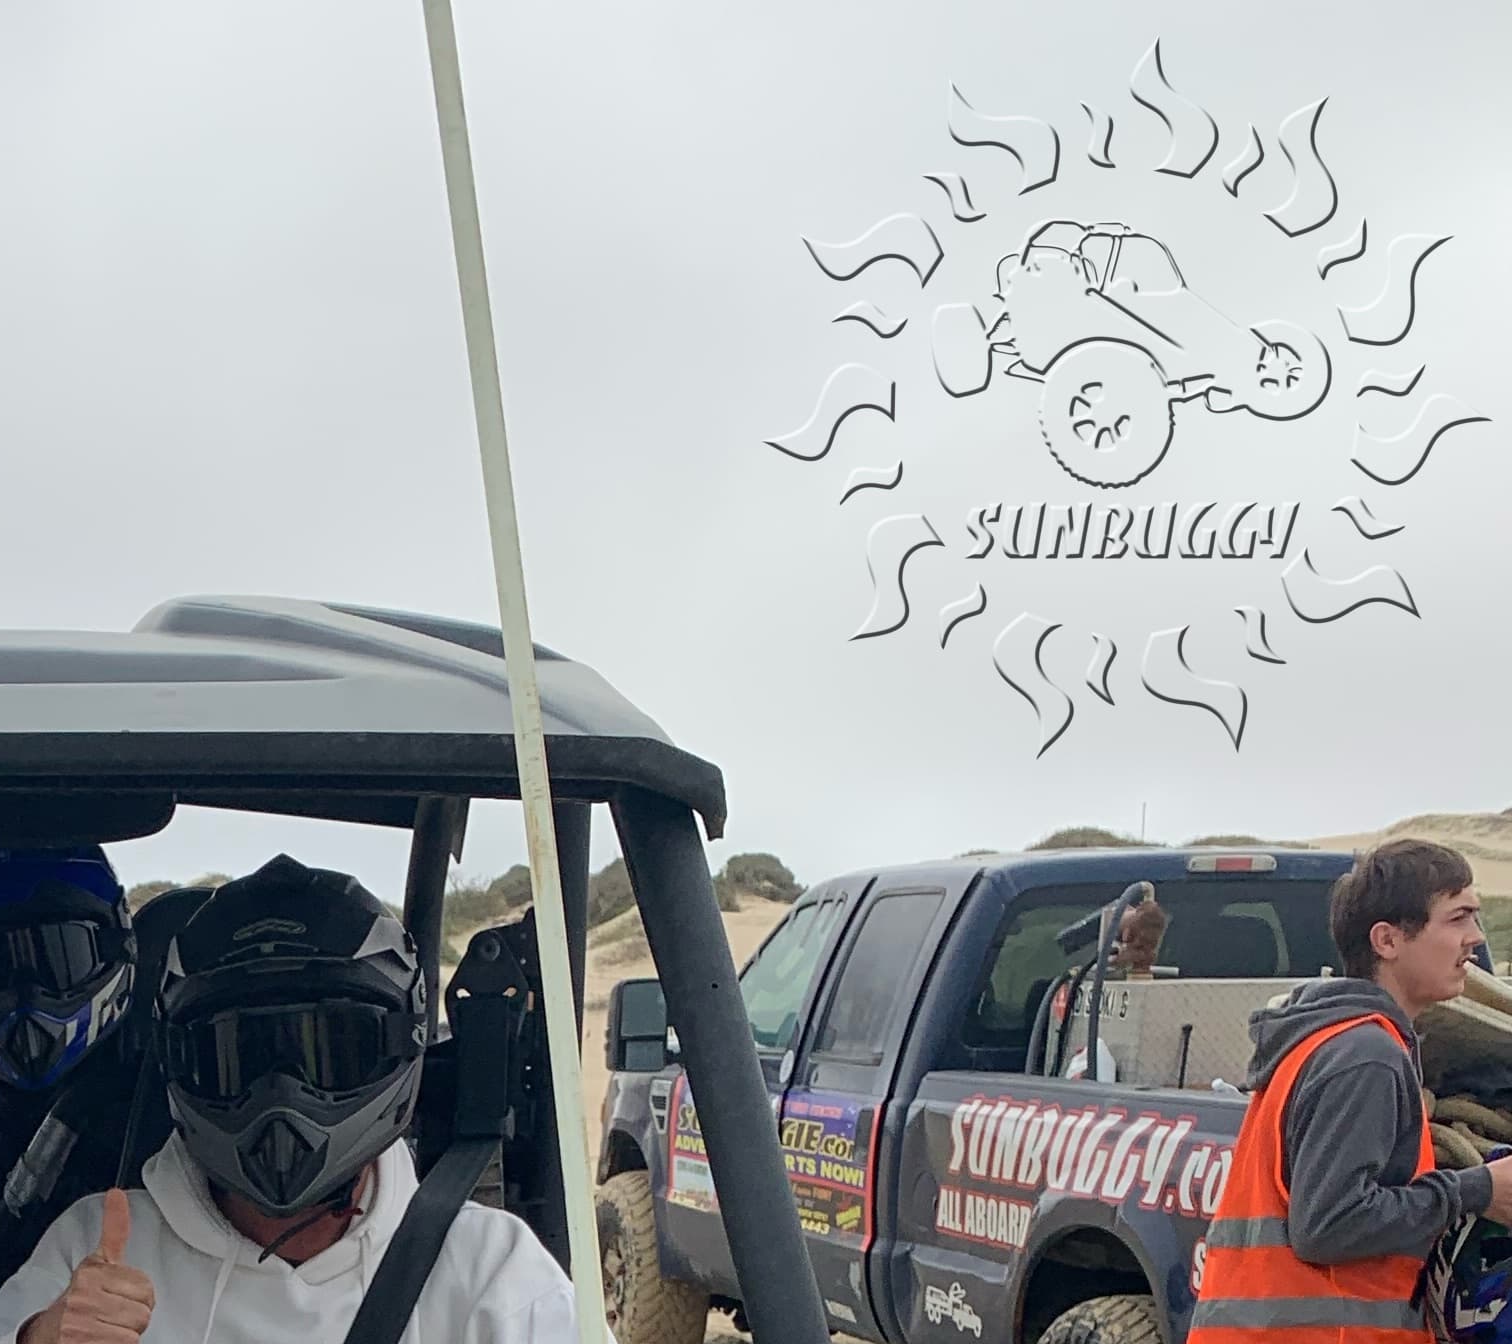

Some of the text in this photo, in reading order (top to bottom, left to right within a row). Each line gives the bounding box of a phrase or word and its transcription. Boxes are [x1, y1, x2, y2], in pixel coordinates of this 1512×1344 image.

[784, 1153, 816, 1177] RTS
[820, 1159, 865, 1189] NOW!
[947, 1096, 1235, 1216] SUNBUGGY.CO
[937, 1187, 1034, 1250] ALL ABOARD
